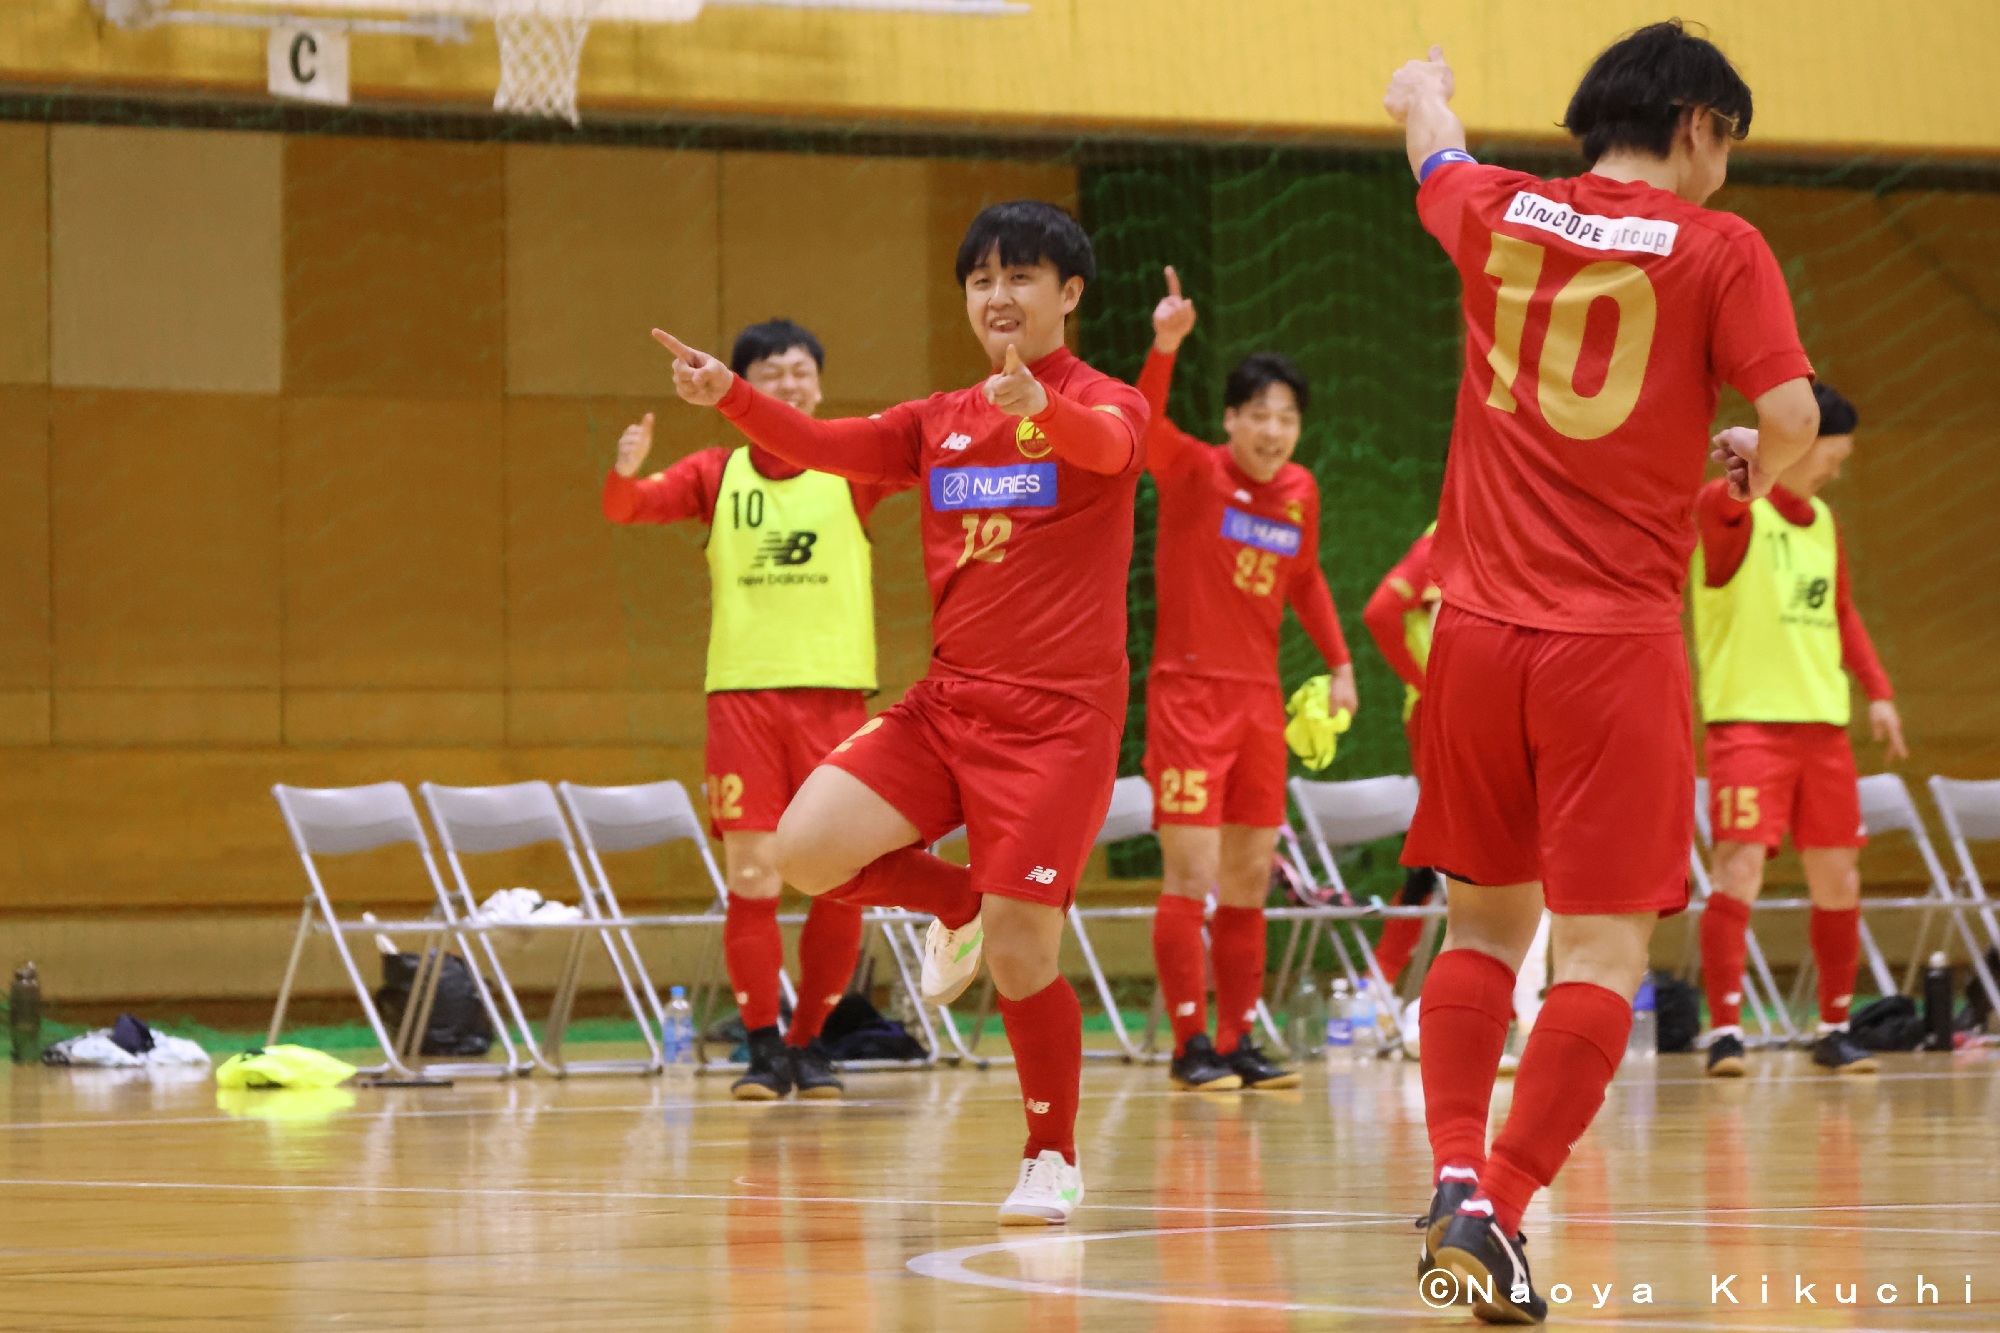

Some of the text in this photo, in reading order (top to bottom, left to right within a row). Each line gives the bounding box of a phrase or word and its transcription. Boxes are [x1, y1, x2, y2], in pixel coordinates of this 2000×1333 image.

[289, 31, 317, 84] C
[1609, 227, 1668, 251] group
[1484, 231, 1657, 440] 10
[972, 474, 1041, 496] NURIES
[730, 488, 764, 529] 10
[956, 513, 1012, 568] 12
[767, 573, 828, 586] balance
[1234, 548, 1276, 596] 25
[1160, 768, 1207, 814] 25
[1718, 786, 1760, 829] 15
